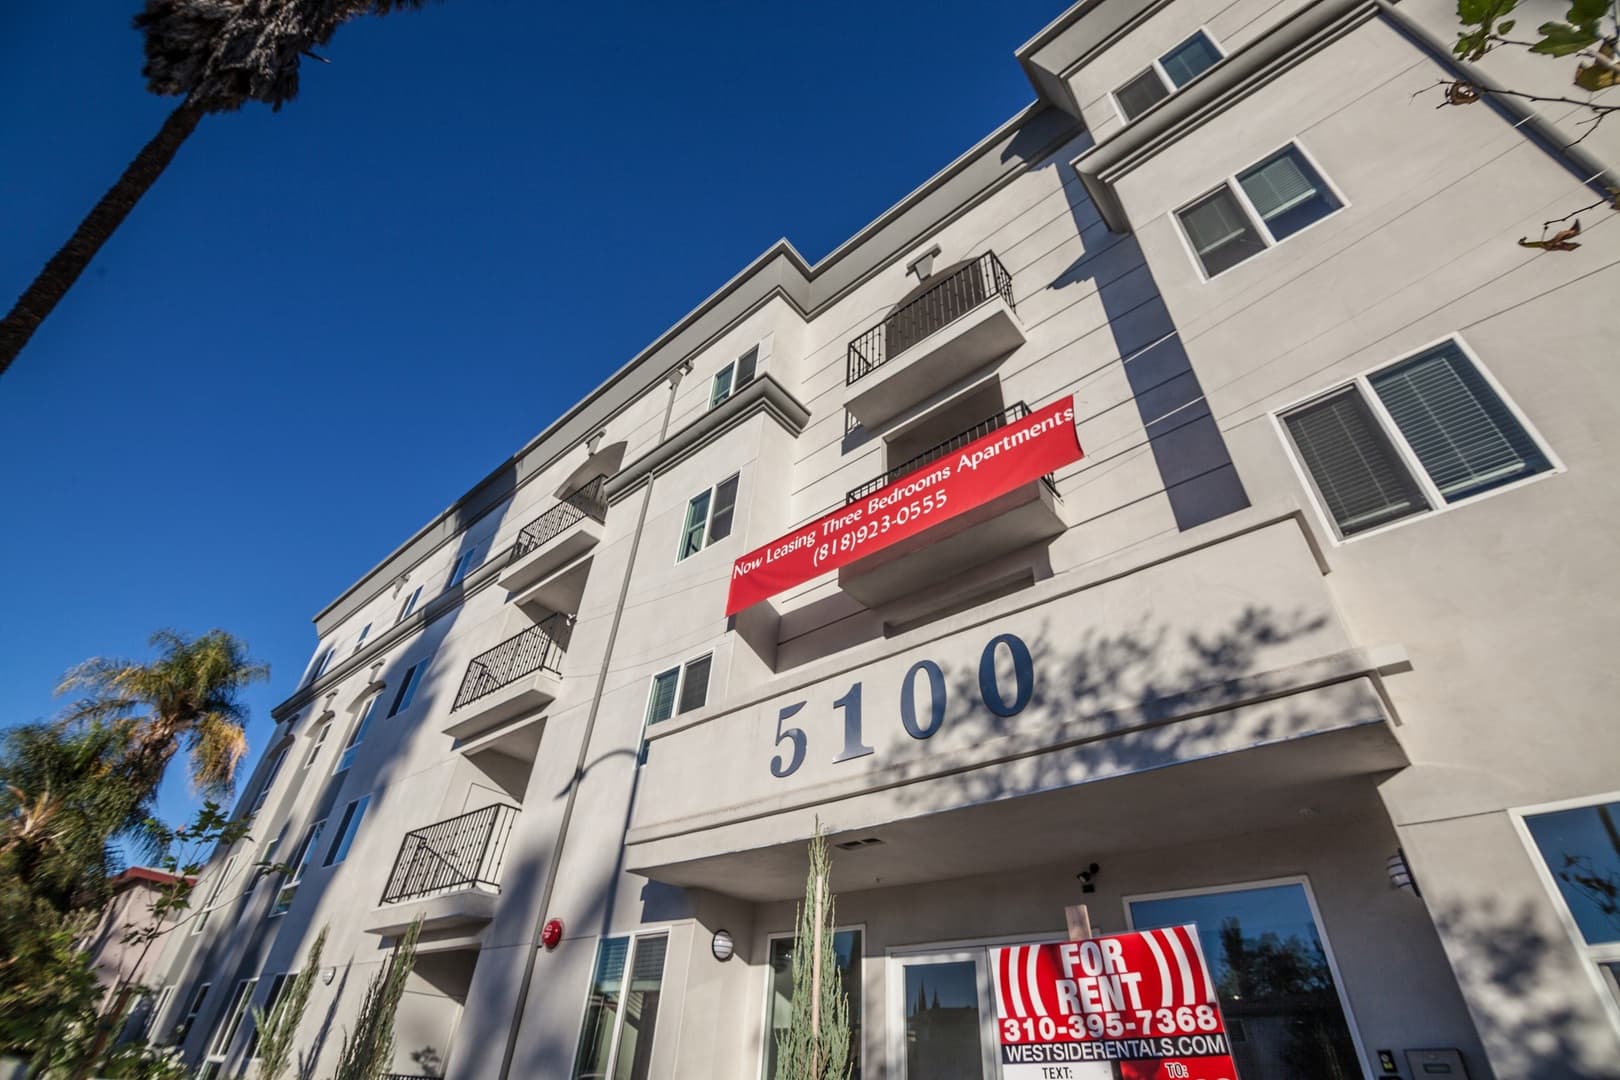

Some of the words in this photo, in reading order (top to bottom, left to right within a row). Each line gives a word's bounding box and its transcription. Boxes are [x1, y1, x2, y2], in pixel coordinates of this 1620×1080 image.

[733, 556, 763, 579] Now
[766, 528, 816, 564] Leasing
[822, 507, 862, 537] Three
[868, 465, 951, 515] Bedrooms
[957, 408, 1074, 473] Apartments
[812, 489, 948, 568] (818)923-0555
[1059, 938, 1128, 978] FOR
[1055, 971, 1143, 1015] RENT
[1003, 1004, 1218, 1042] 310-395-7368
[1005, 1034, 1226, 1063] WESTSIDERENTALS.COM
[1042, 1066, 1073, 1079] TEXT:
[1165, 1062, 1190, 1078] TO:
